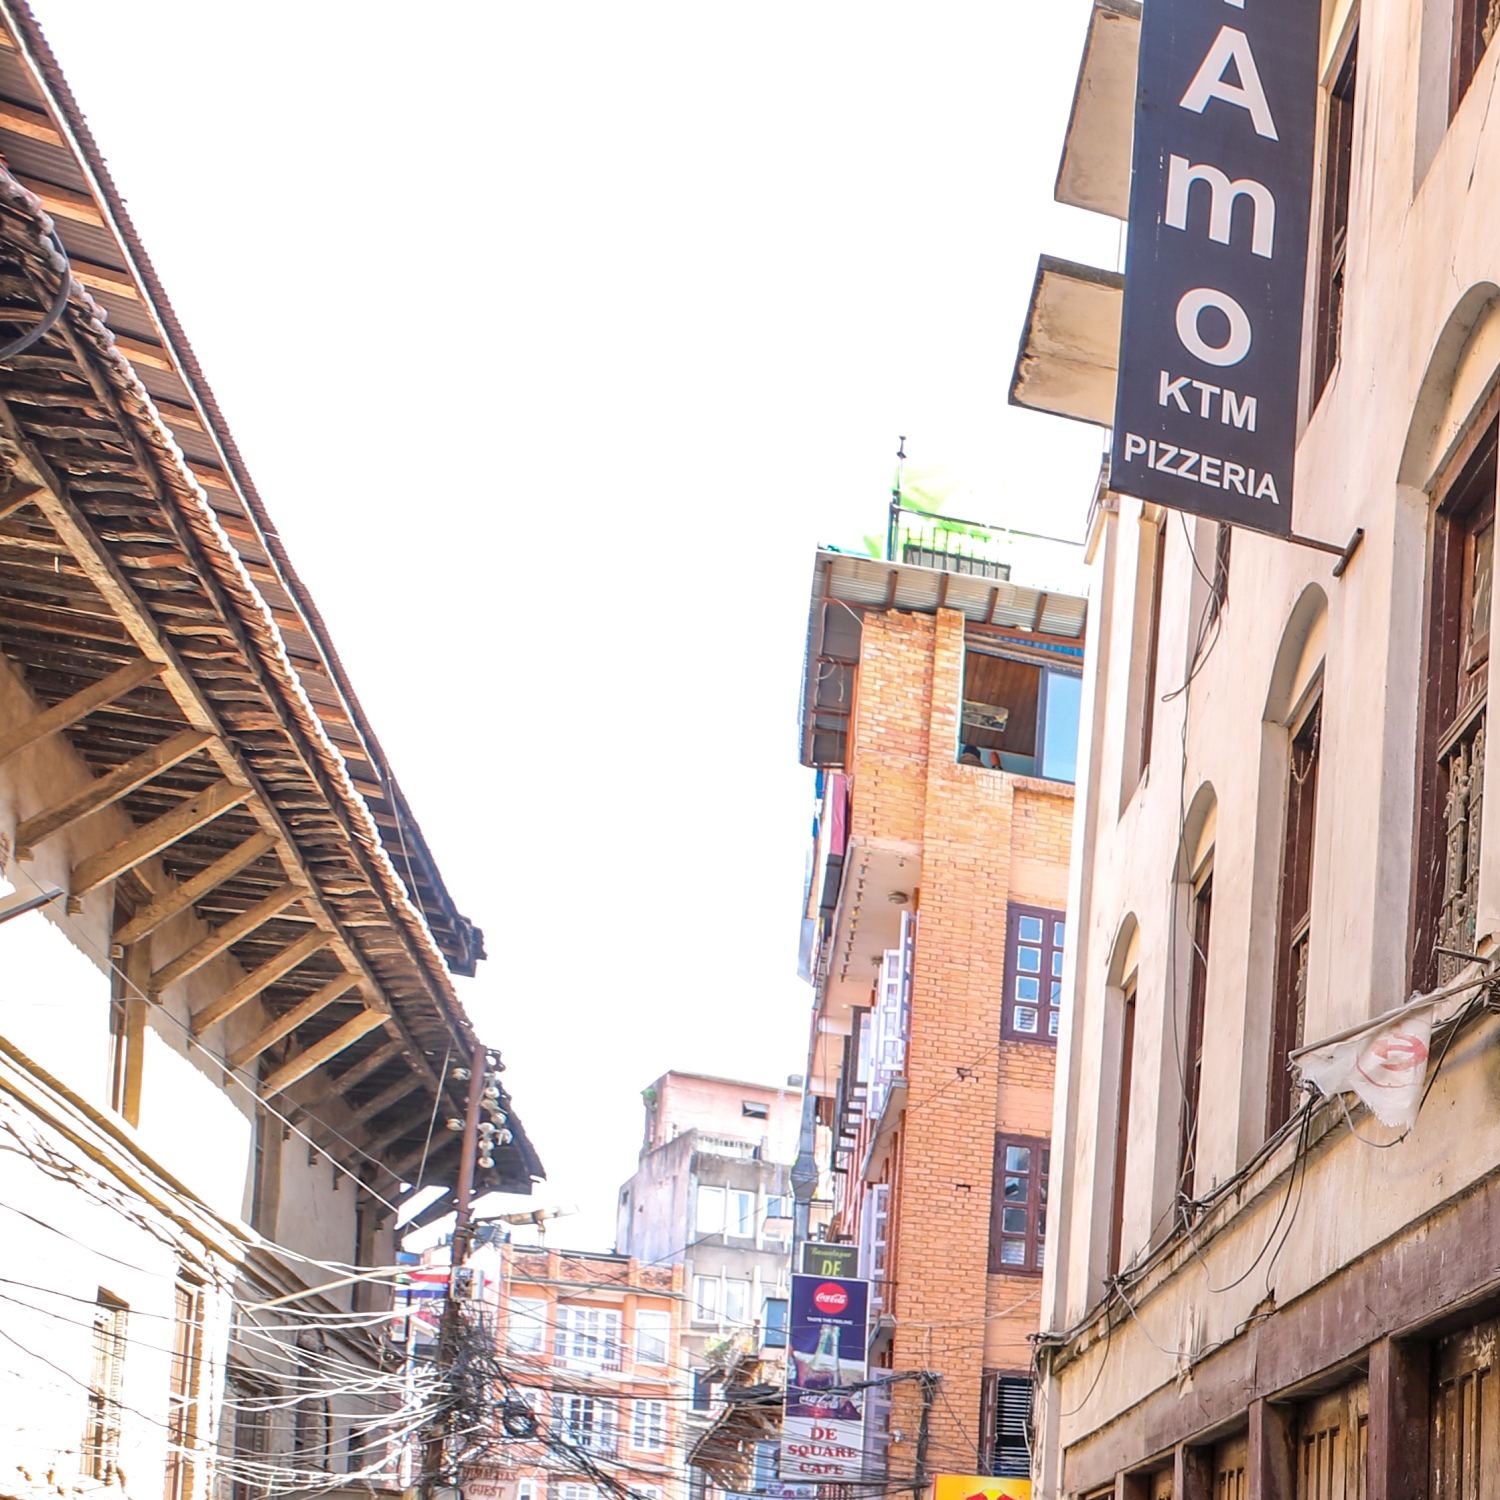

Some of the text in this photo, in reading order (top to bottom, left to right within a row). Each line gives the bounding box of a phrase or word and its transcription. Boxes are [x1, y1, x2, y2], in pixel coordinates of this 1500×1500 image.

[1165, 0, 1279, 367] Amo
[1158, 370, 1257, 432] KTM
[1124, 432, 1280, 505] PIZZERIA
[810, 1427, 838, 1441] DE
[788, 1444, 857, 1459] SQUARE
[799, 1462, 845, 1476] CAFE
[469, 1484, 506, 1498] GUEST
